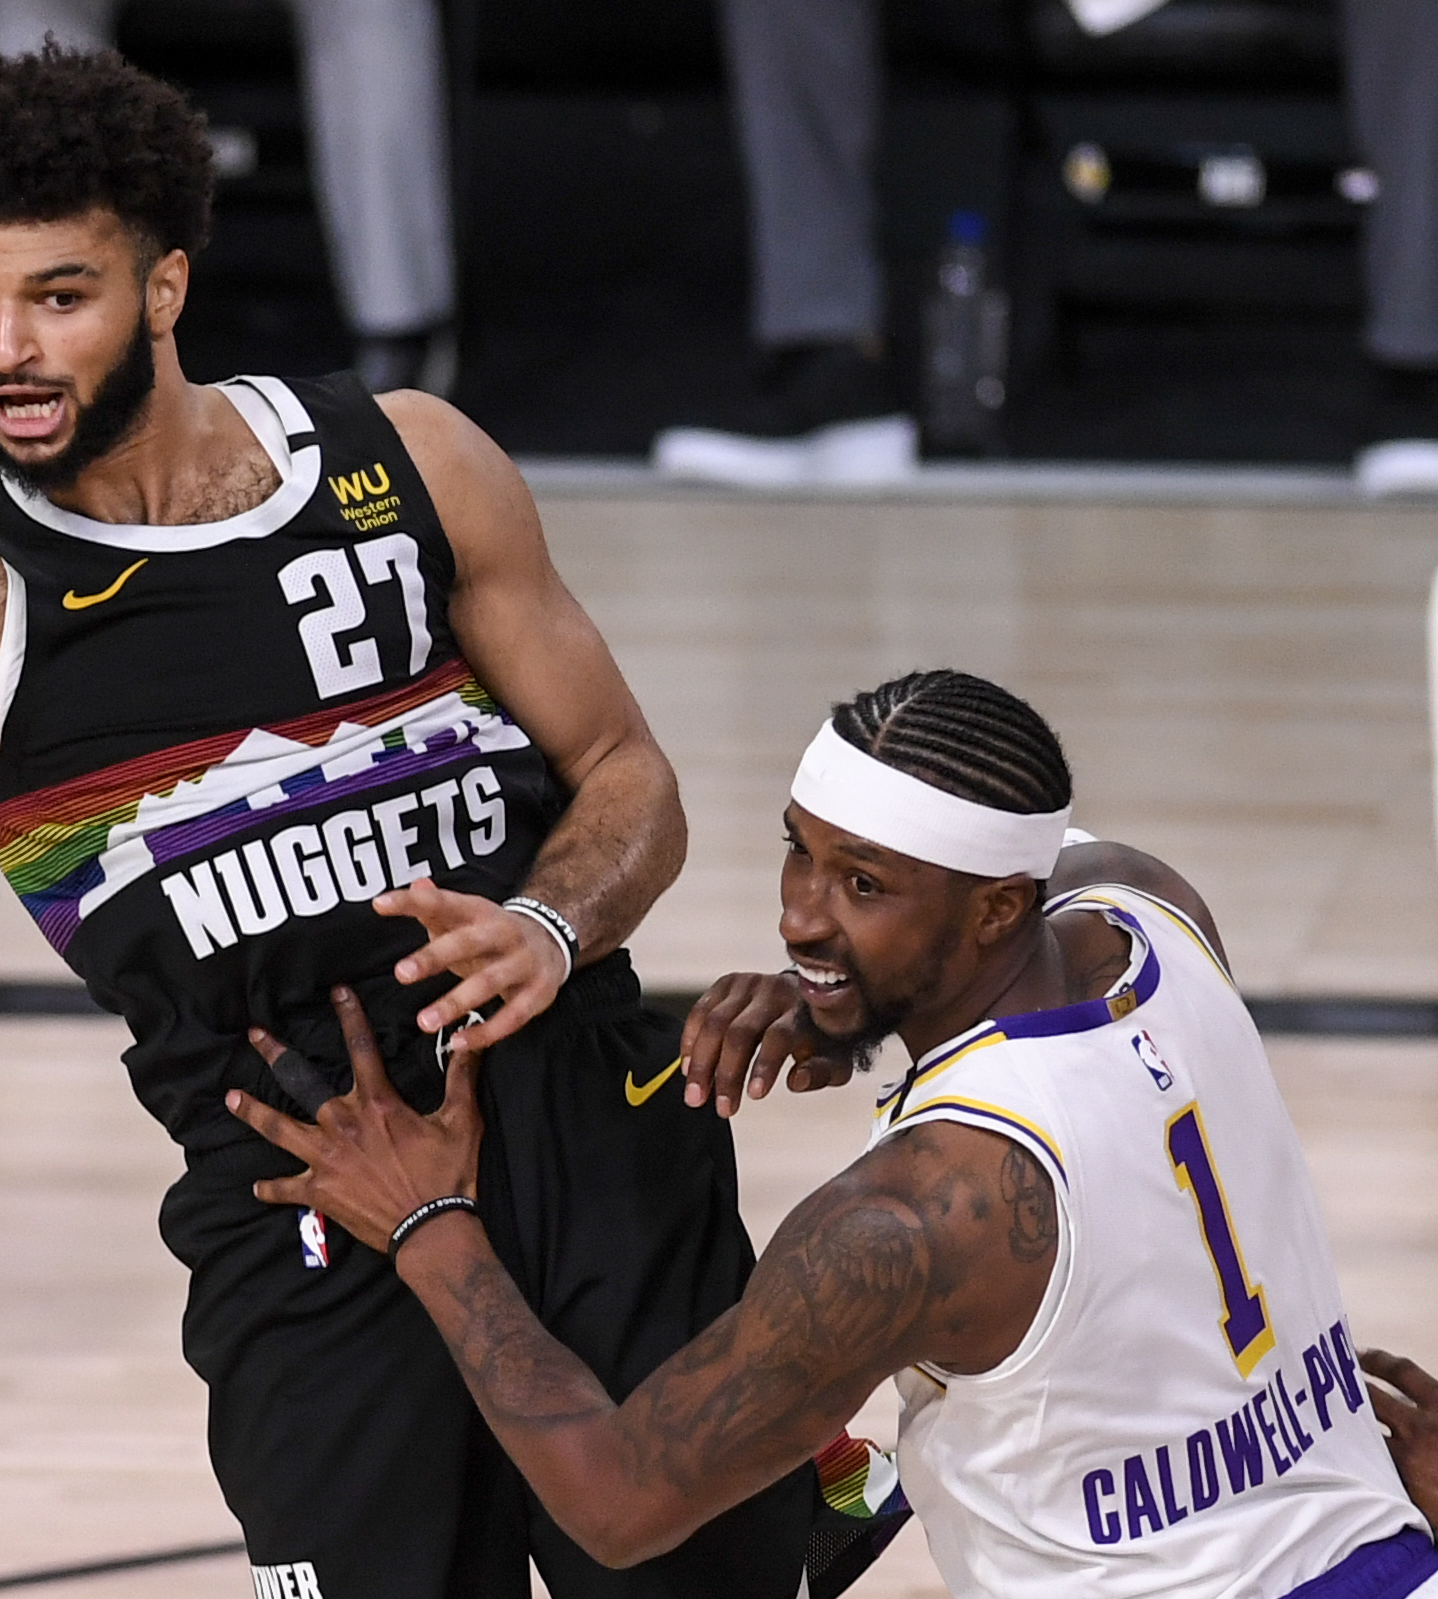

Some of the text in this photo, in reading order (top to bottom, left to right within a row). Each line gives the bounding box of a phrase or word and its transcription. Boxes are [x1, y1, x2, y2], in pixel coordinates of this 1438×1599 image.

[327, 462, 390, 505] WU
[339, 495, 401, 521] Western
[354, 511, 399, 532] Union
[277, 532, 433, 699] 27
[161, 766, 506, 960] NUGGETS
[1164, 1100, 1275, 1381] 1
